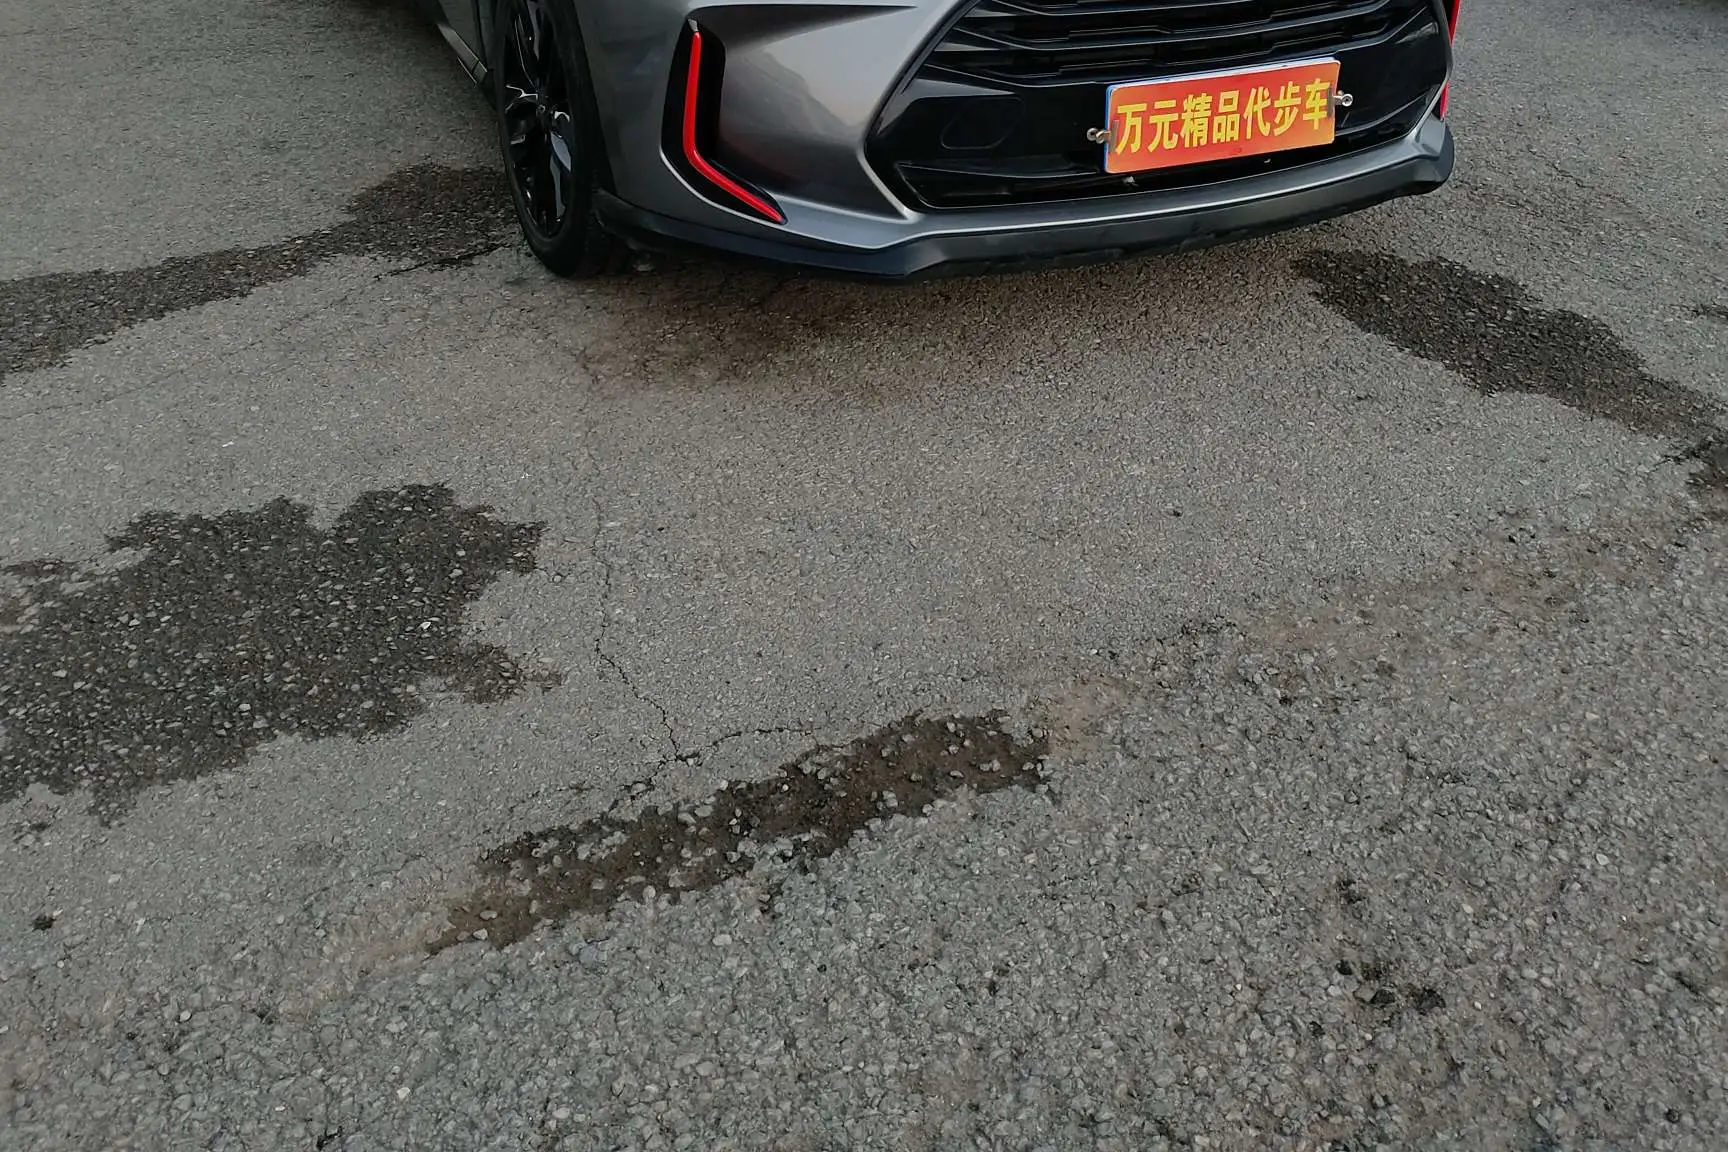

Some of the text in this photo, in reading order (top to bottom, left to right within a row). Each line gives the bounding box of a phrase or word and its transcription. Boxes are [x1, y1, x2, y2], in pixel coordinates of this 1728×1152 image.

[1115, 78, 1331, 156] 万元精品代步车
